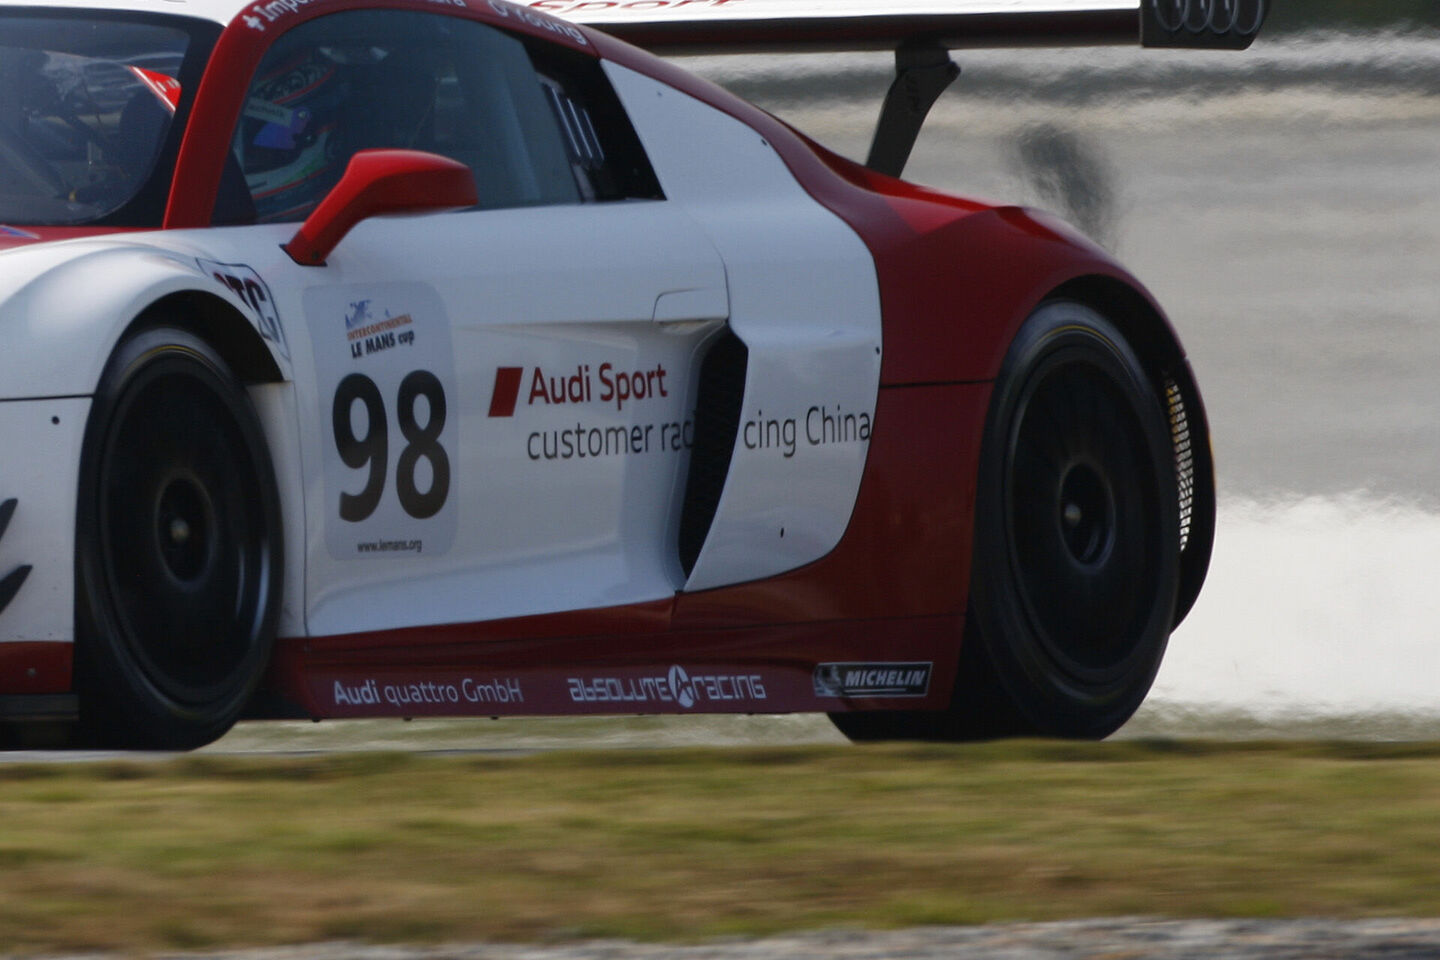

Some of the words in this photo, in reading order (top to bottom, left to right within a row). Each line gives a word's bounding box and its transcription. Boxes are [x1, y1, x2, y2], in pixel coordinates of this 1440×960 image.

[350, 341, 363, 359] LE
[365, 332, 396, 355] MANS
[398, 330, 415, 346] cup
[527, 365, 592, 405] Audi
[599, 362, 669, 411] Sport
[331, 369, 451, 524] 98
[526, 421, 654, 461] customer
[805, 404, 873, 451] China
[334, 679, 381, 705] Audi
[383, 681, 459, 707] quattro
[461, 678, 525, 703] GmbH
[844, 669, 927, 688] MICHELIN
